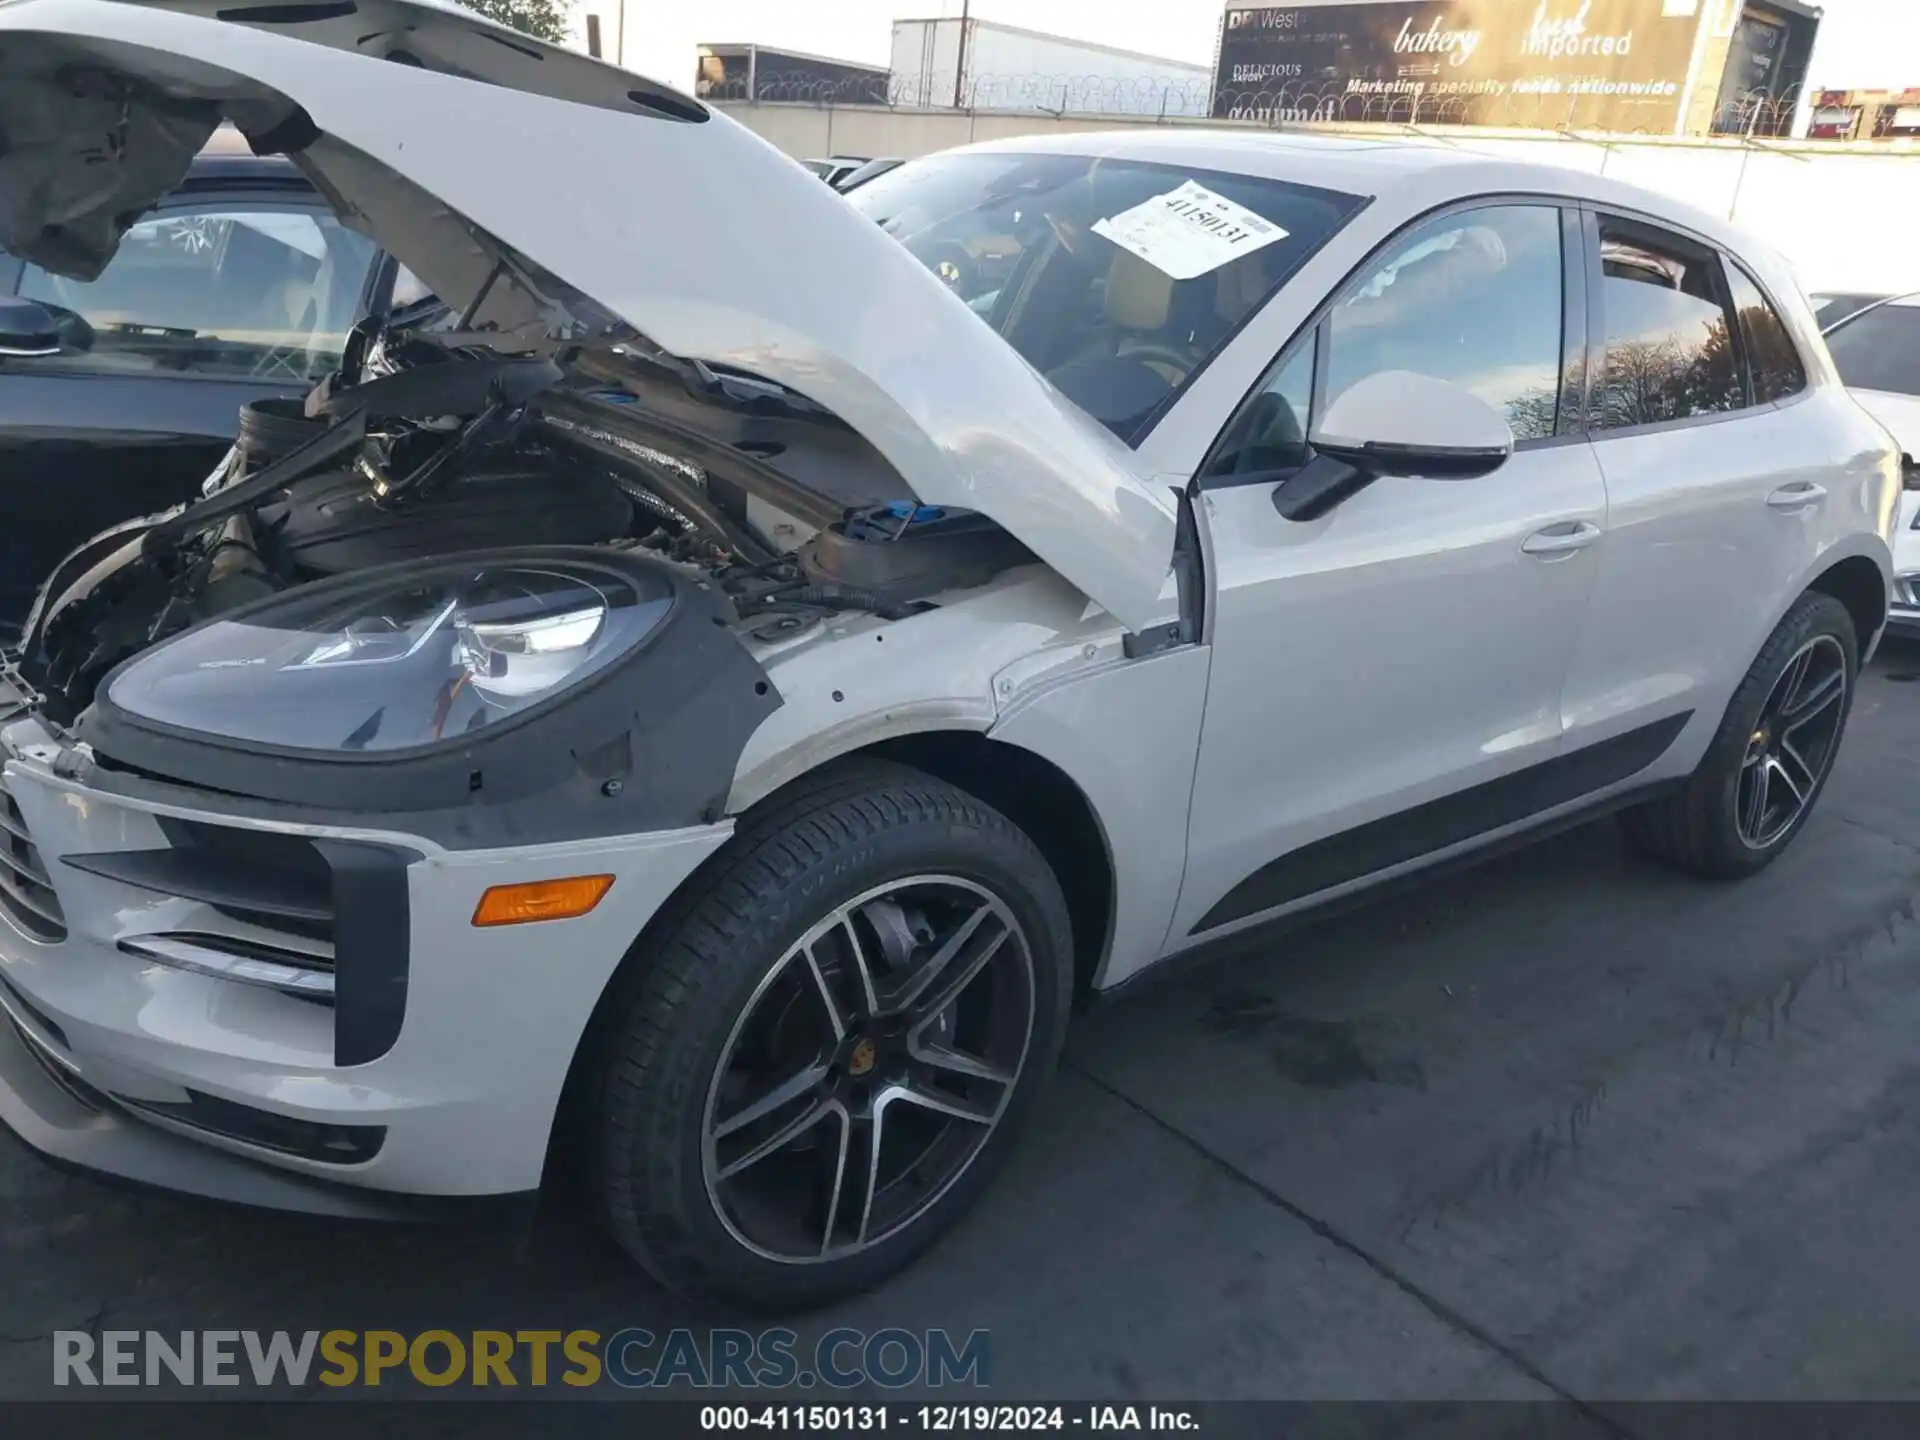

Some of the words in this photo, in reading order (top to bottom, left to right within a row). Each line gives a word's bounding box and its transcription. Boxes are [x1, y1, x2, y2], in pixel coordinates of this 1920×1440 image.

[1261, 9, 1299, 28] West
[1393, 16, 1482, 67] bakery
[1519, 30, 1632, 60] imported
[1232, 63, 1302, 77] DELICIOUS
[1346, 78, 1425, 95] Marketing
[1428, 79, 1507, 97] specialty
[1567, 78, 1677, 95] nationwide
[1165, 199, 1249, 243] 41150131
